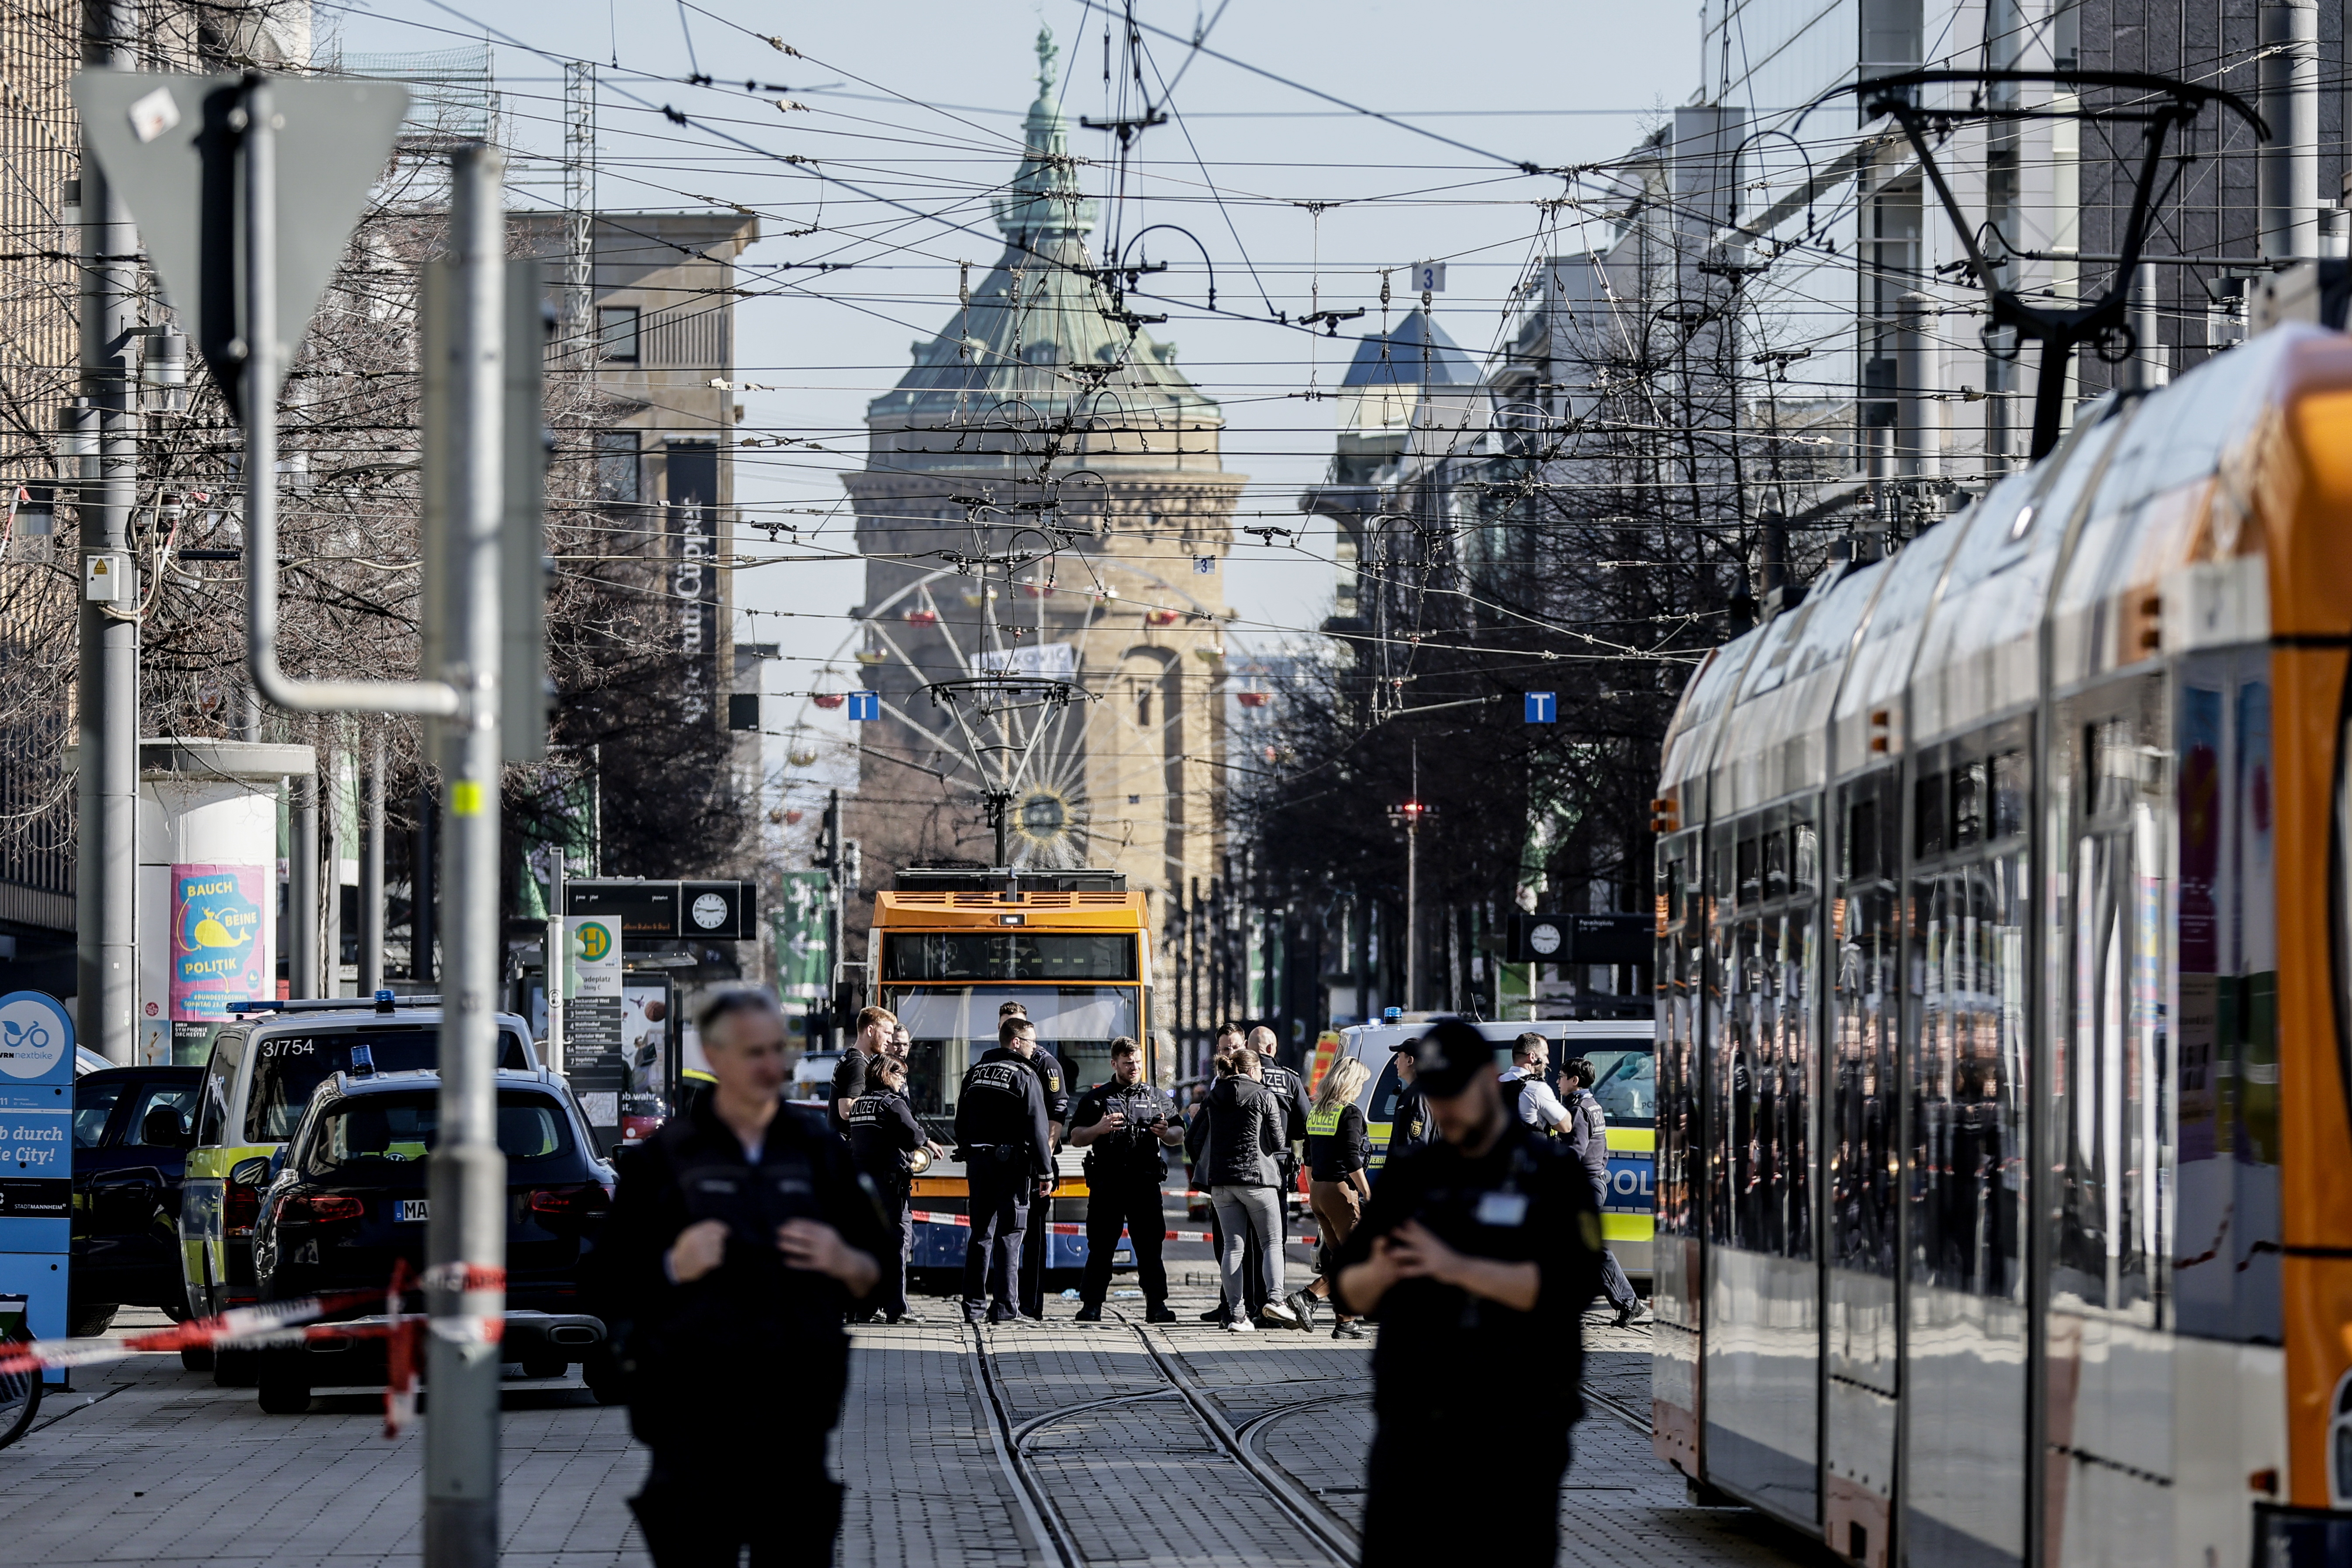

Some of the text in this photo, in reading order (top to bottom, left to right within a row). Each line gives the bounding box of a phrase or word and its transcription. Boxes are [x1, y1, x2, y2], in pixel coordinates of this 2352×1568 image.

[1424, 268, 1433, 289] 3
[1201, 559, 1207, 573] 3
[853, 693, 873, 719] T
[1531, 694, 1550, 721] T
[187, 881, 232, 897] BAUCH
[225, 912, 257, 927] BEINE
[185, 957, 237, 975] POLITIK
[263, 1039, 314, 1057] 3/754
[1307, 1113, 1337, 1126] POLIZEI
[13, 1126, 63, 1141] durch
[16, 1147, 55, 1165] City!
[404, 1202, 428, 1219] MA
